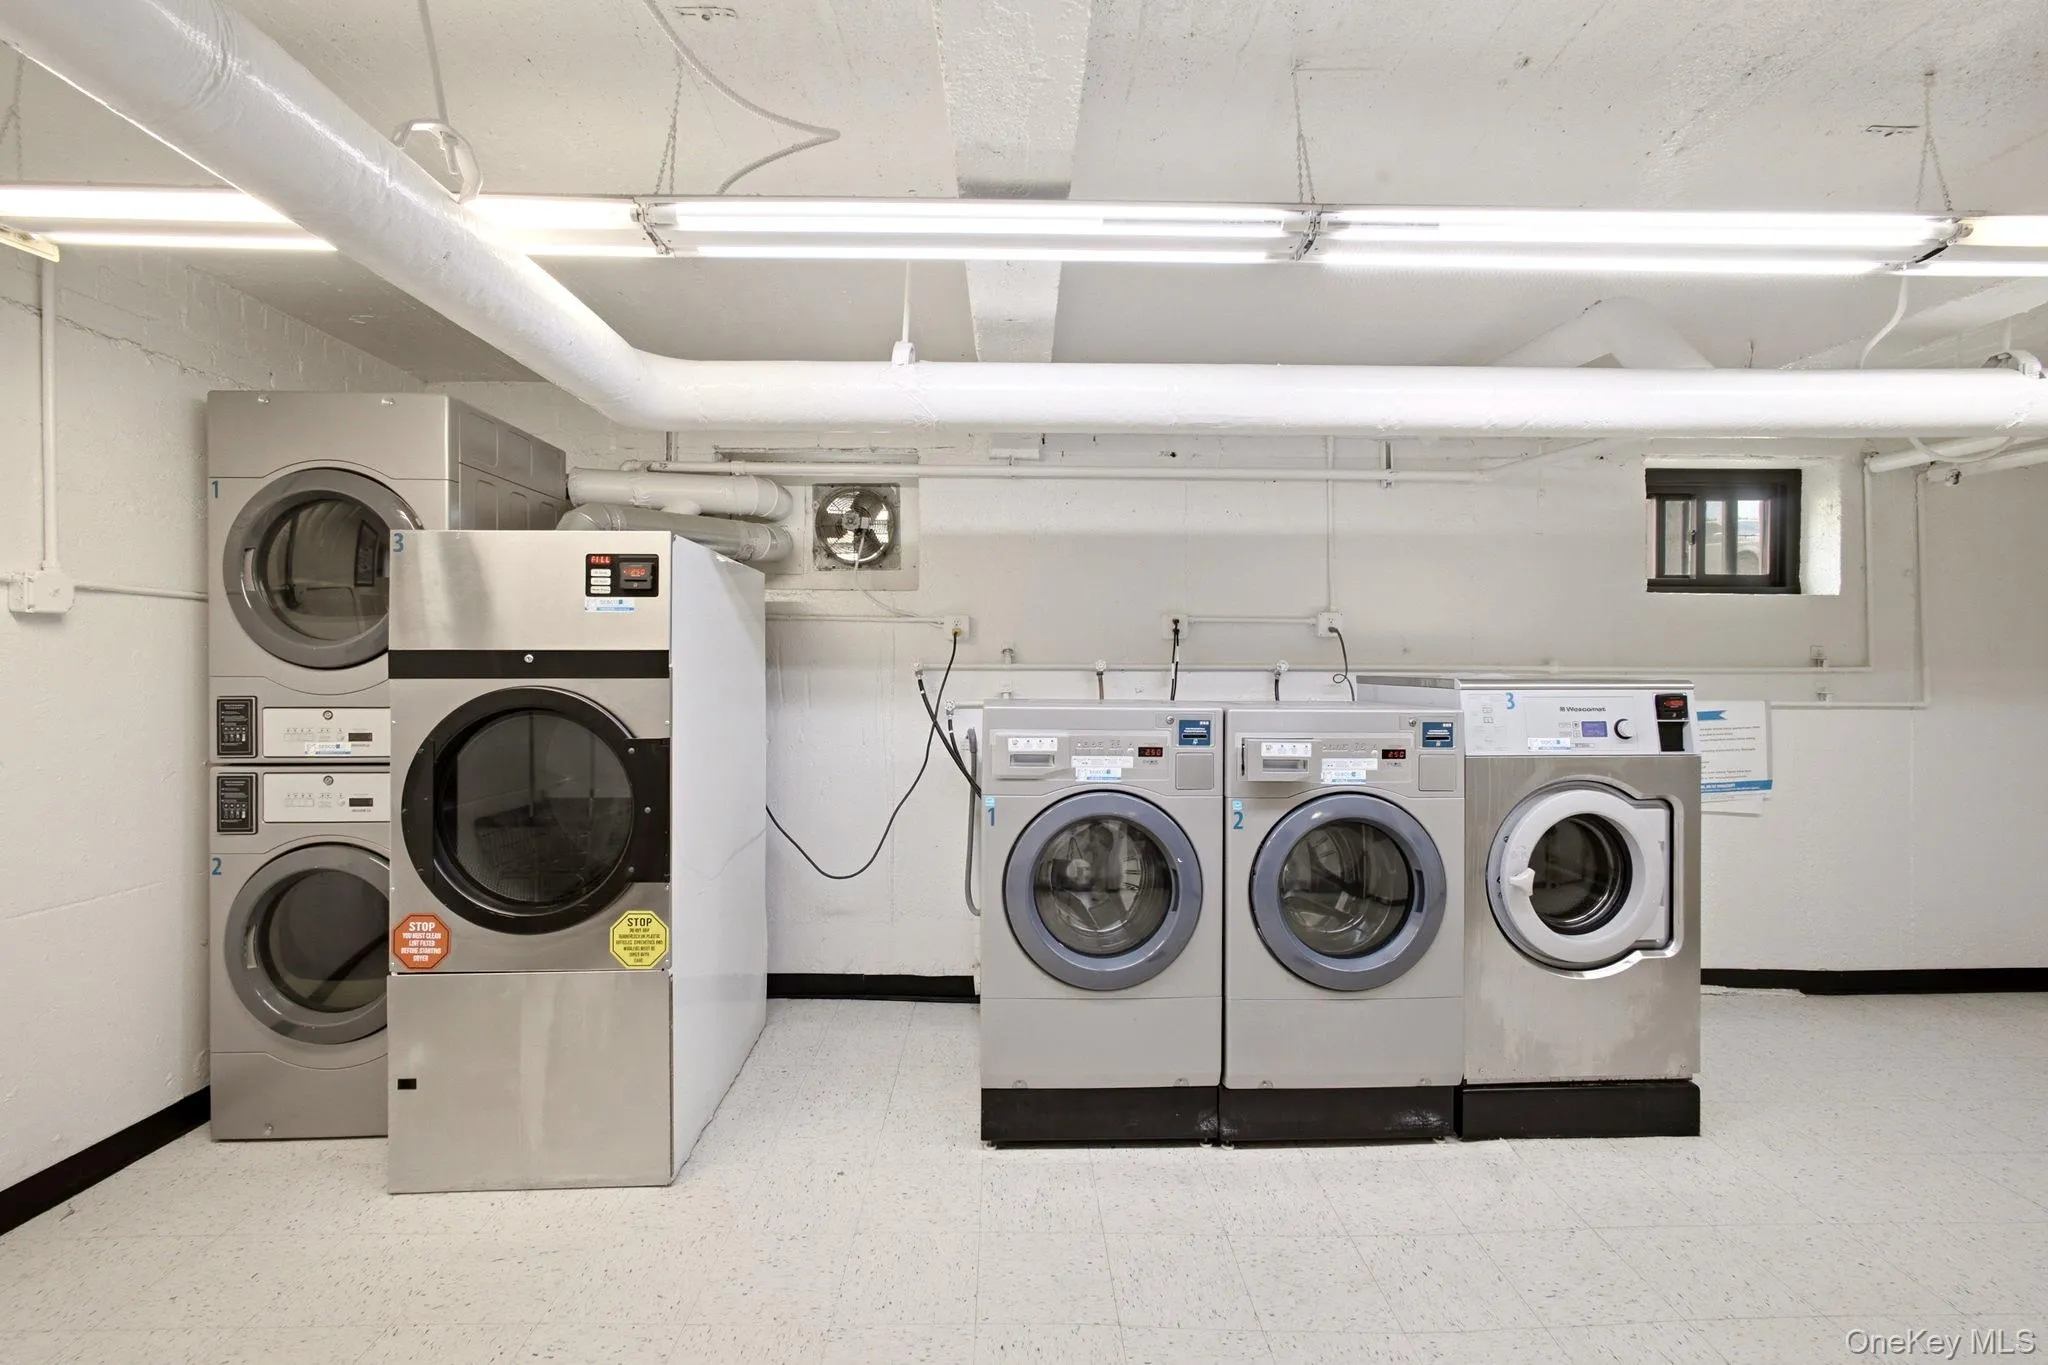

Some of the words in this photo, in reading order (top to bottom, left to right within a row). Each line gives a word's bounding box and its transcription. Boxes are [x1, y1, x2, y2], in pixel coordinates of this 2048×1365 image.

[212, 480, 219, 499] 1
[393, 533, 404, 553] 3
[1505, 692, 1516, 710] 3
[987, 807, 995, 826] 1
[1233, 811, 1244, 830] 2
[211, 857, 222, 876] 2
[409, 921, 436, 931] STOP
[627, 918, 652, 926] STOP
